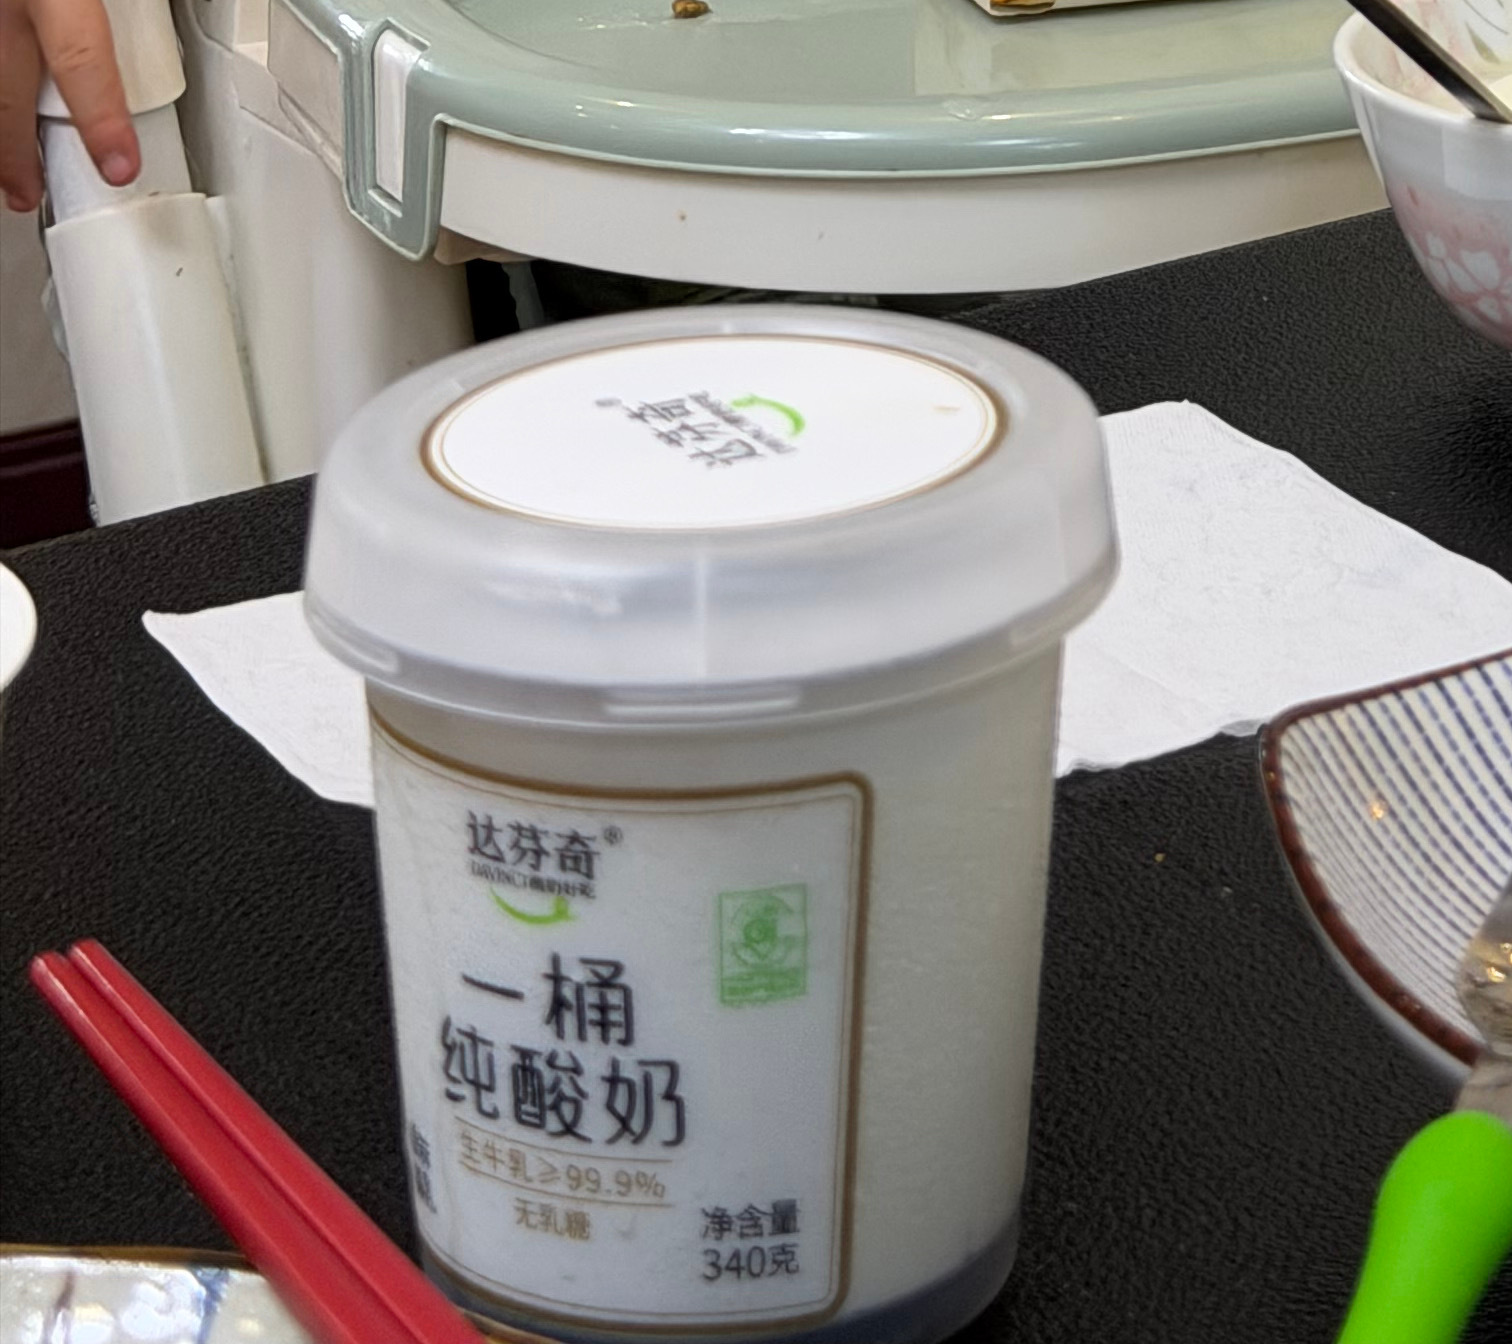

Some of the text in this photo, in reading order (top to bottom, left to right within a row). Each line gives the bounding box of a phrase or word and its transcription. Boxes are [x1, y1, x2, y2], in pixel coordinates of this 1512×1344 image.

[466, 810, 601, 880] 达芬奇
[461, 950, 635, 1047] 一桶
[441, 1014, 686, 1148] 纯酸奶
[514, 1197, 591, 1241] 无乳糖
[702, 1198, 801, 1241] 净含量
[703, 1242, 800, 1282] 340克
